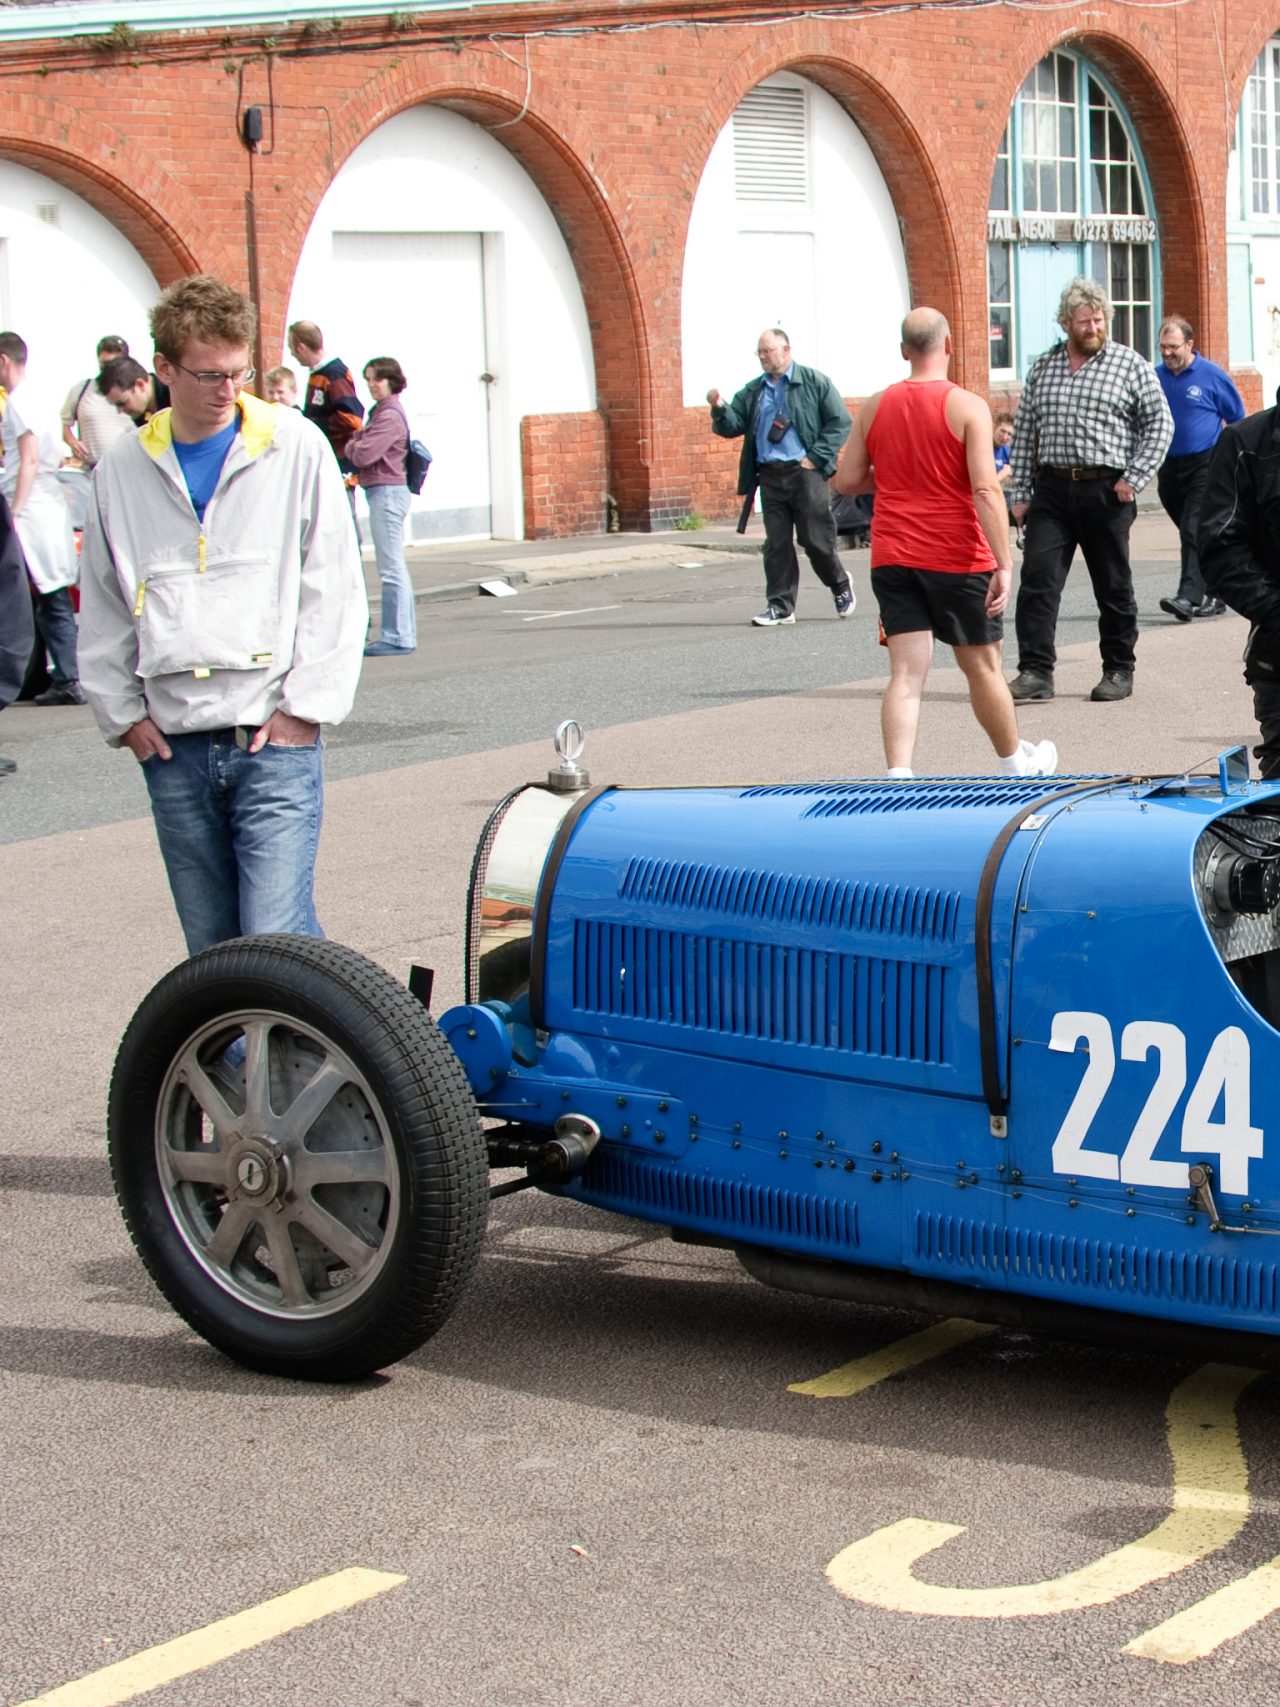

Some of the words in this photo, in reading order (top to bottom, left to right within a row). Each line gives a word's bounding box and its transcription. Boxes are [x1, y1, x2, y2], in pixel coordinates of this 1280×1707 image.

[1018, 218, 1056, 240] NEON
[1073, 220, 1108, 241] 01273
[1112, 221, 1156, 241] 694662
[1048, 1011, 1264, 1196] 224
